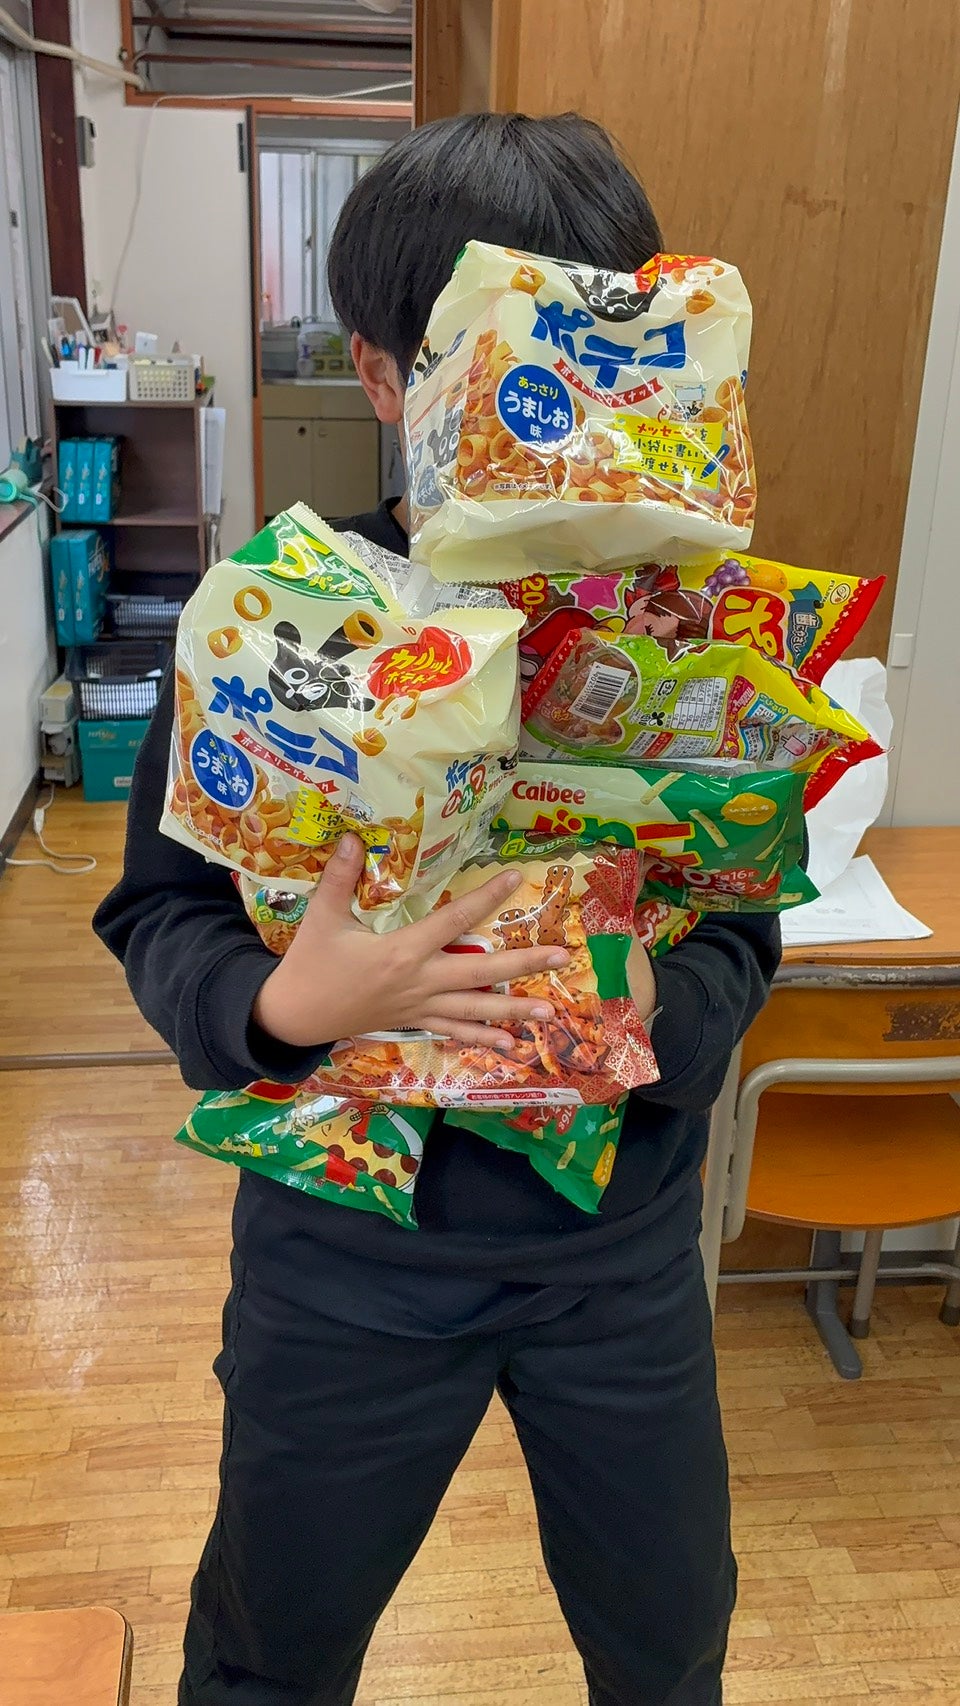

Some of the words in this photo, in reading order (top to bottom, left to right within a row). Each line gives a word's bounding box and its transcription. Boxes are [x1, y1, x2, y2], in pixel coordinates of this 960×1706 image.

[531, 300, 686, 389] ポテコ
[518, 375, 559, 400] あっさり
[503, 390, 570, 430] うましお
[529, 423, 543, 439] 味
[382, 646, 453, 675] カリッと
[196, 747, 249, 797] うましお
[216, 780, 229, 797] 味
[511, 780, 587, 805] Calbee
